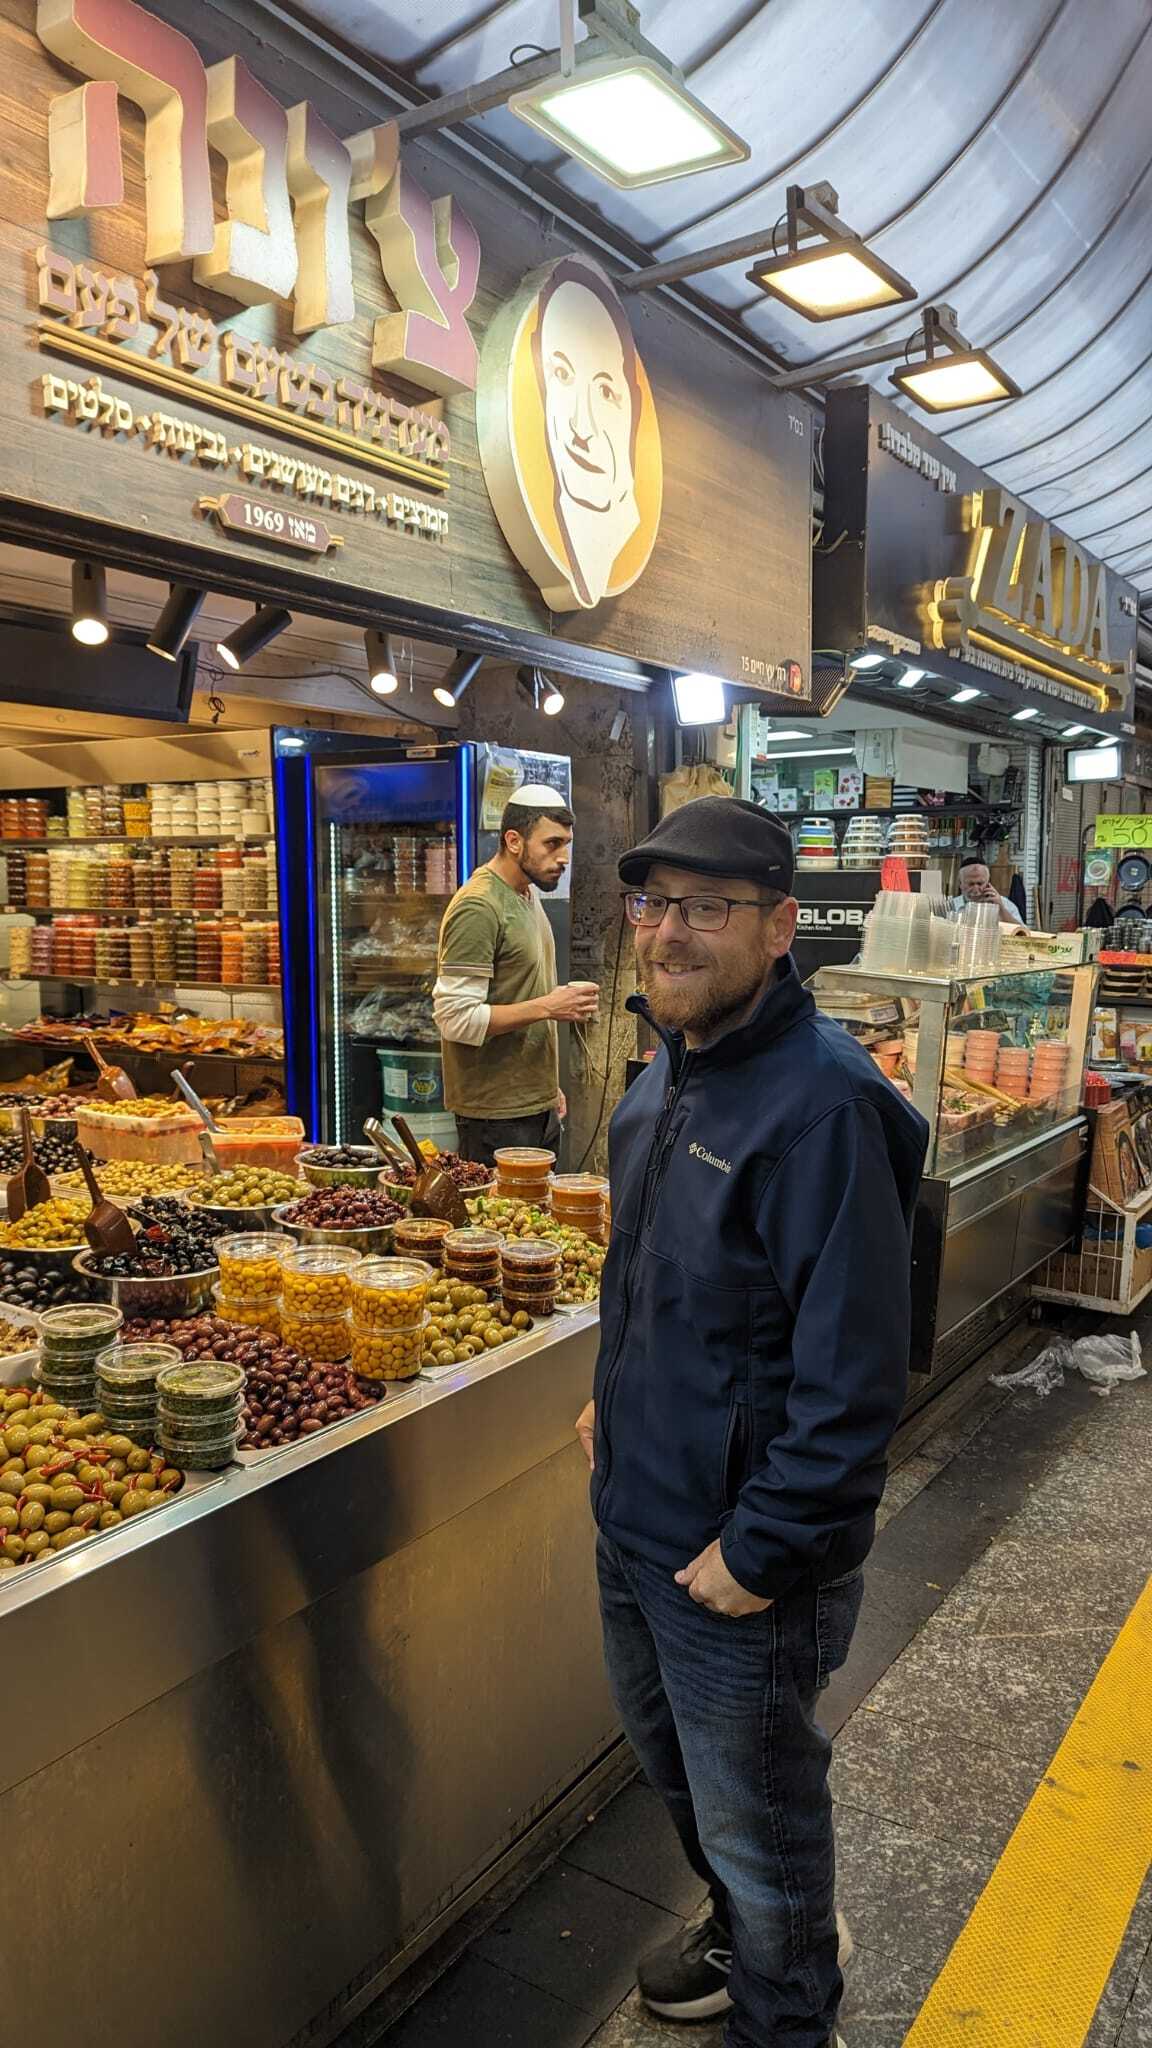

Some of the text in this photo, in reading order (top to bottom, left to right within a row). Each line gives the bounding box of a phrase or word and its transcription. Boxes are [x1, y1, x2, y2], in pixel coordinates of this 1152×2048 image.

[36, 244, 141, 340] פעם
[144, 269, 218, 369] של
[42, 373, 133, 431] סלטים
[152, 411, 228, 465] גבינות
[332, 474, 376, 512] דגים
[244, 503, 317, 544] מאז 1969
[387, 493, 449, 535] חמוצים
[741, 656, 750, 672] 15
[751, 660, 765, 676] חיים
[796, 908, 864, 926] GLOB
